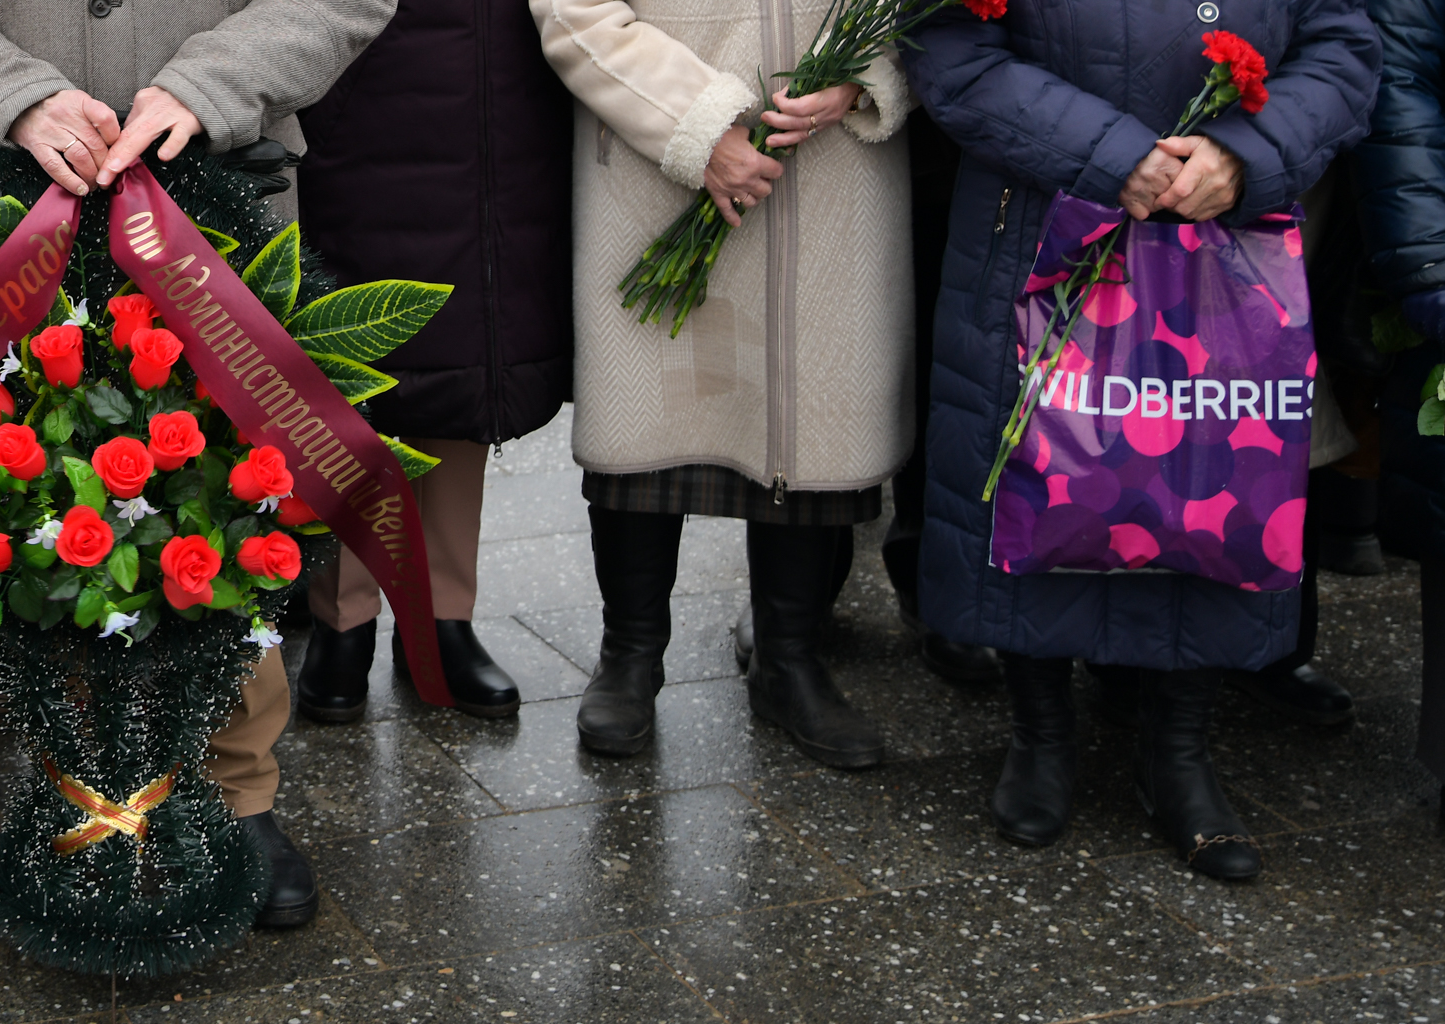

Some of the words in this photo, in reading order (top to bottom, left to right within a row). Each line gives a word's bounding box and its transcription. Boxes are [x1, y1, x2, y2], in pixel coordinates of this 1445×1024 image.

[122, 210, 167, 262] от
[157, 252, 368, 496] Администрации
[349, 476, 379, 510] и
